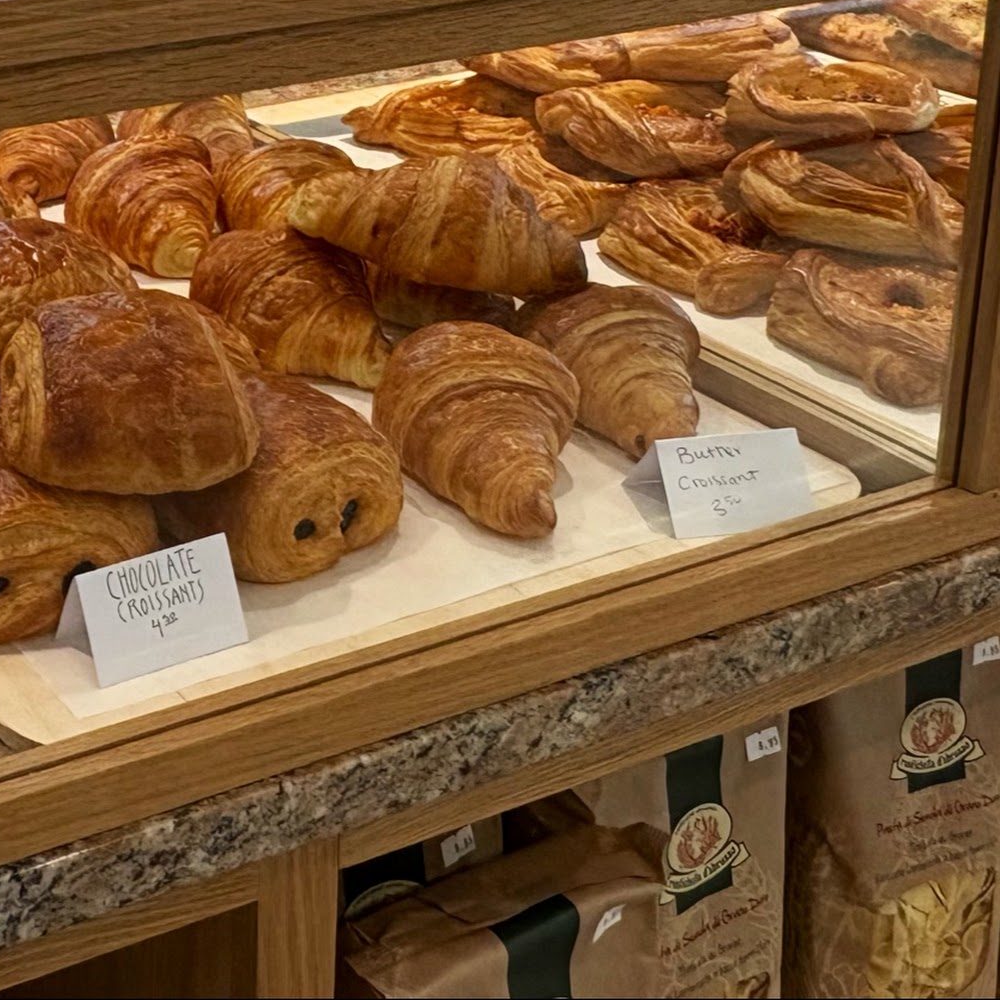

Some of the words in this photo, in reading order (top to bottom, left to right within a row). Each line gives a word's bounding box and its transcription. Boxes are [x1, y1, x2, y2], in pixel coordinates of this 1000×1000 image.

[678, 470, 760, 491] Croissant
[106, 548, 201, 600] CHOCOLATE
[117, 579, 204, 623] CROISSANTS
